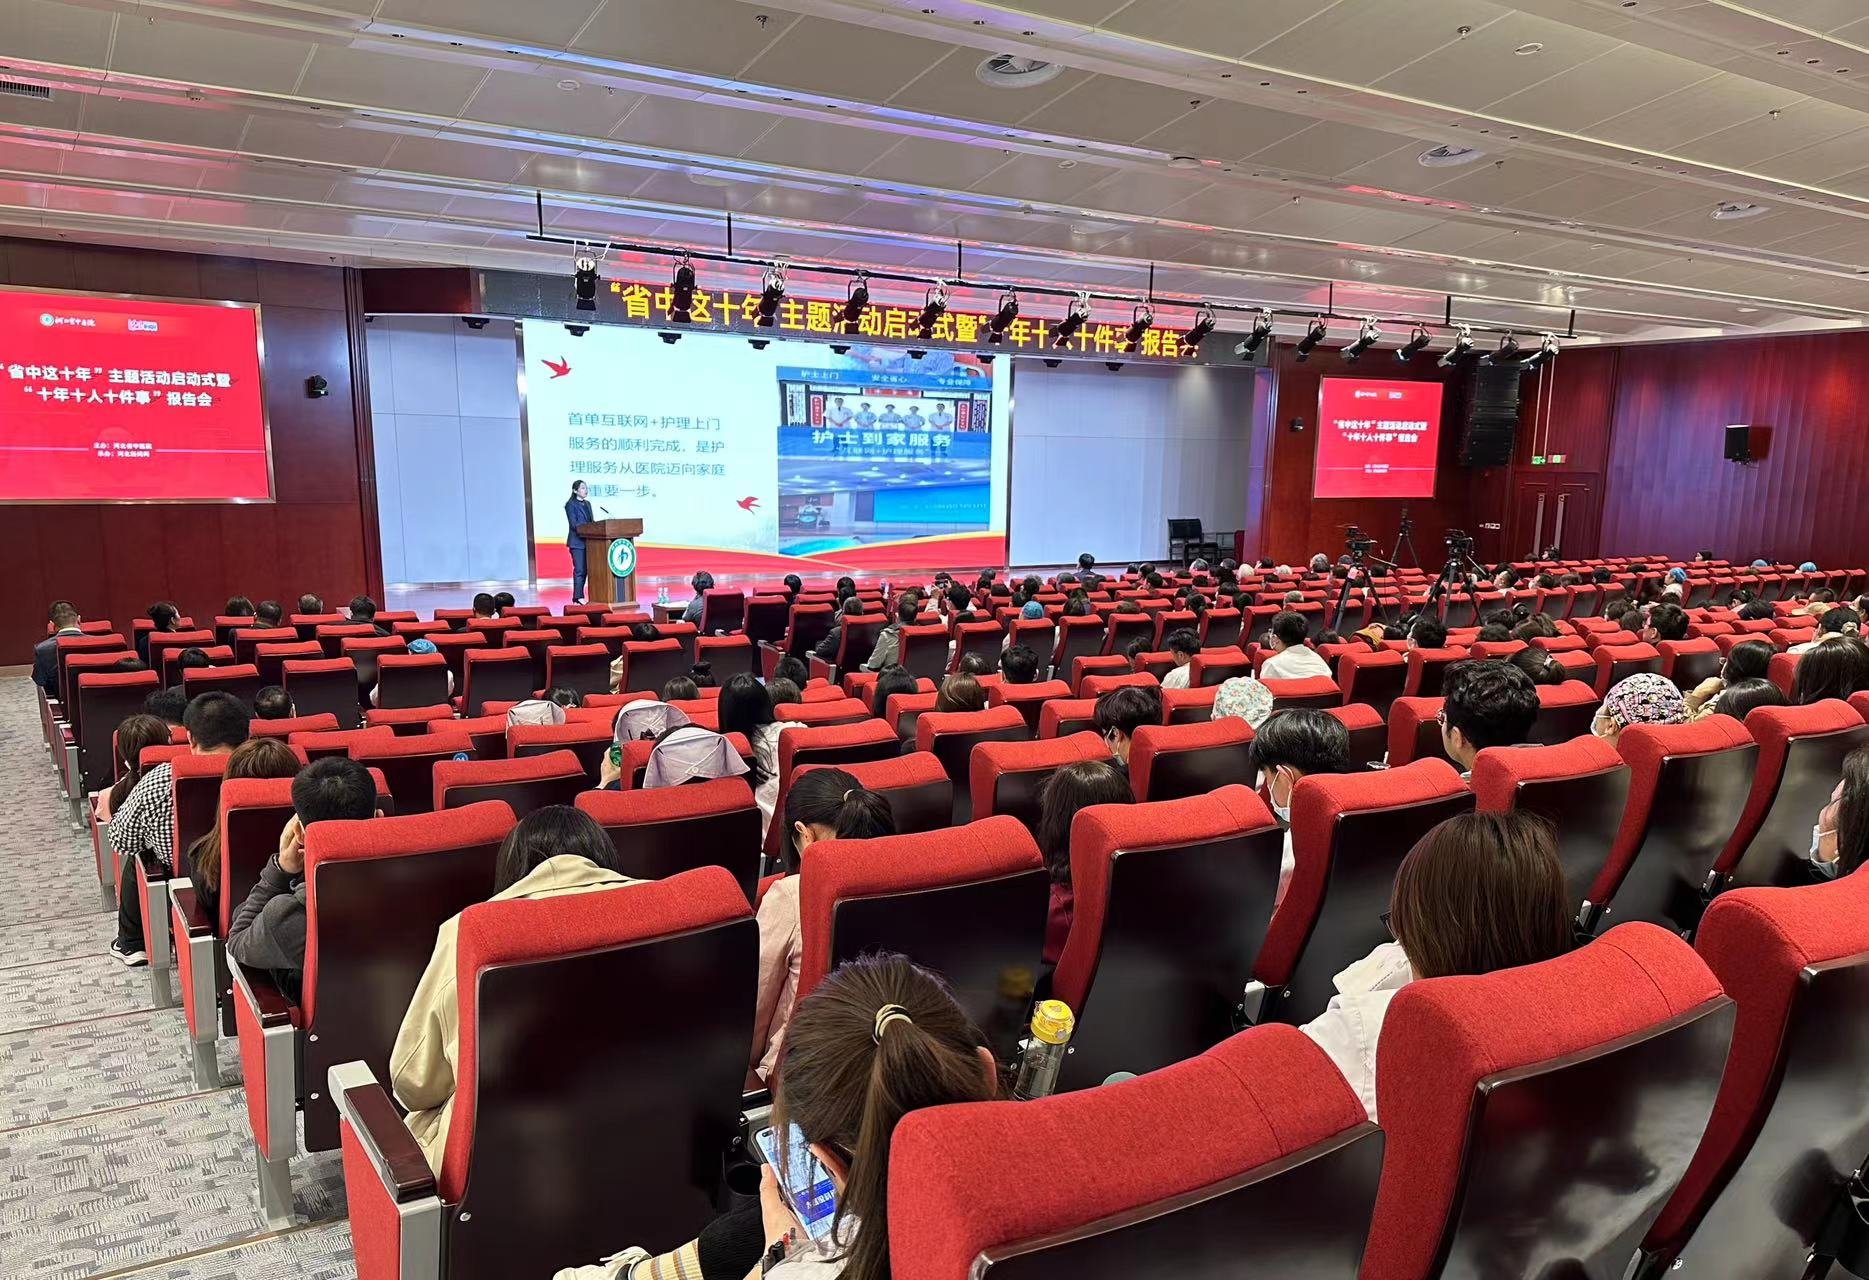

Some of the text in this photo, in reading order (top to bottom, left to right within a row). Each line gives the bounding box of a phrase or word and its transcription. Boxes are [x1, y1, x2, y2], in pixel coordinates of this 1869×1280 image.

[24, 386, 212, 407] “十年十人十件事”报告会
[812, 430, 951, 447] 护士到家服务
[570, 460, 725, 476] 理服务从医院迈向家庭
[588, 484, 656, 498] 重要一步。
